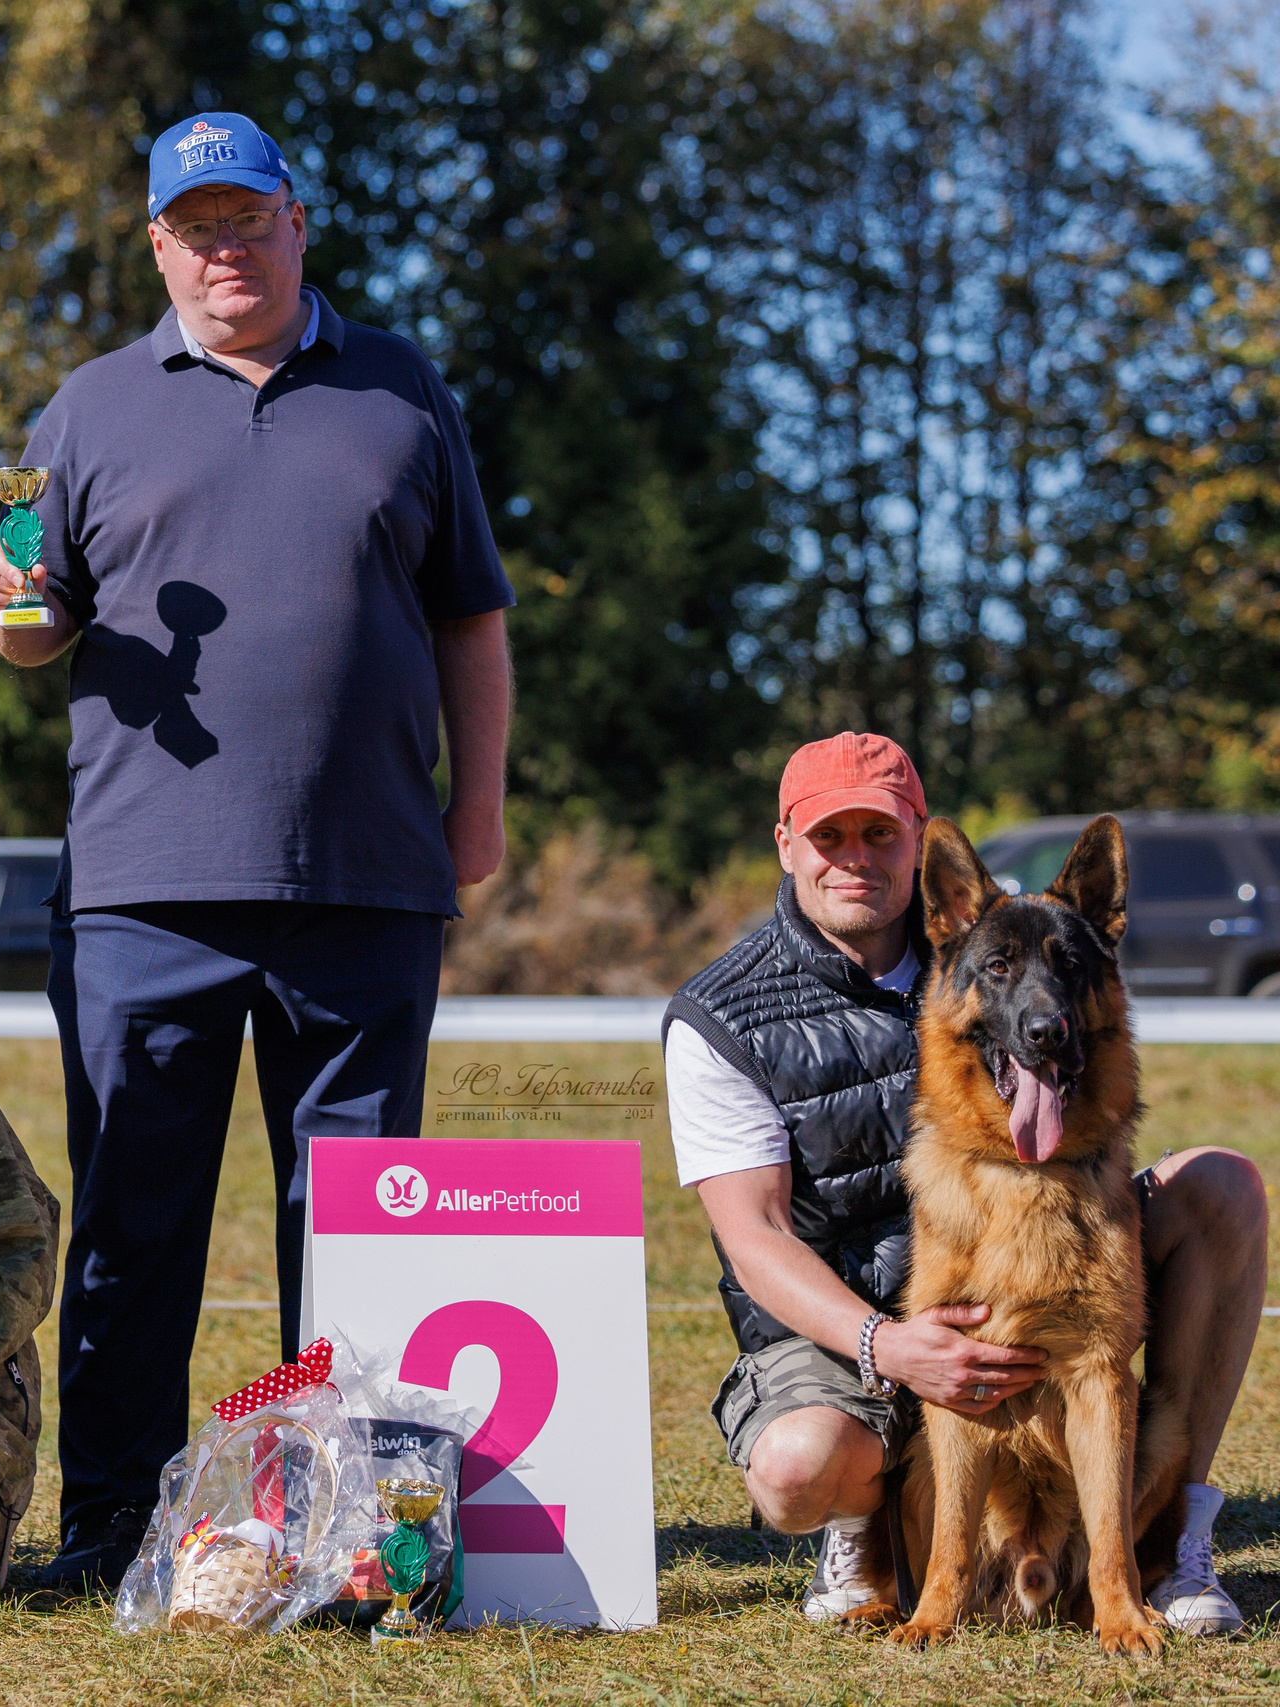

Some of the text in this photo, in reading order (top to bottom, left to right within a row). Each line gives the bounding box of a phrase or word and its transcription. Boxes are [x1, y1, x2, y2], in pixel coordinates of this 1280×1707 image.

[180, 142, 238, 174] 1946
[436, 1188, 580, 1213] AllerPetfood
[398, 1300, 567, 1554] 2
[371, 1432, 421, 1452] elwin
